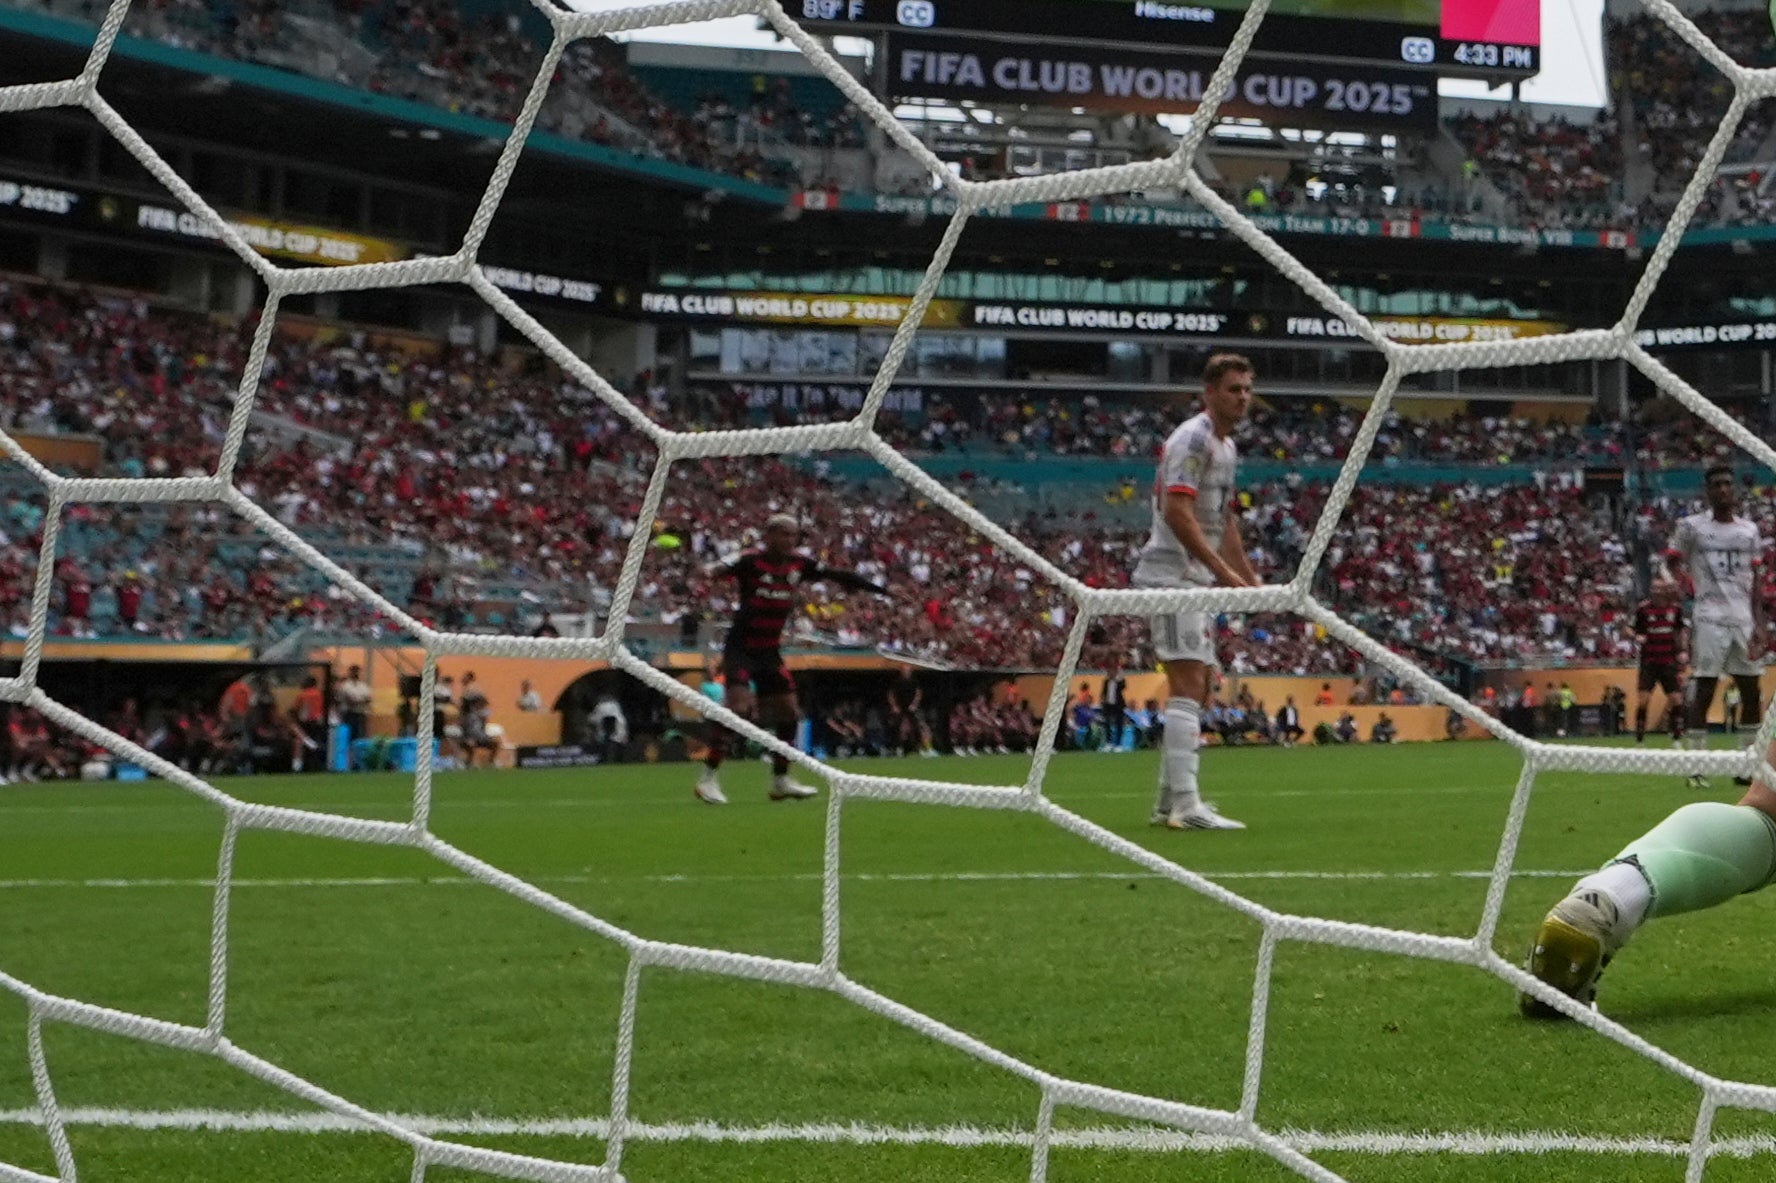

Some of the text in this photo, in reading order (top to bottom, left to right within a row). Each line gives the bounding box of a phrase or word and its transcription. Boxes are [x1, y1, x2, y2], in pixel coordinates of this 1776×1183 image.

[1135, 0, 1215, 24] Hisense
[1503, 46, 1532, 68] PM
[902, 49, 984, 88] FIFA
[993, 53, 1092, 95] CLUB
[1243, 75, 1318, 108] CUP
[138, 205, 177, 233] FIFA
[642, 293, 680, 314] FIFA
[681, 294, 734, 315] CLUB
[735, 298, 808, 318] WORLD
[810, 300, 850, 319] CUP
[975, 306, 1015, 326] FIFA
[1016, 307, 1065, 327] CLUB
[1067, 309, 1133, 330] WORLD
[1136, 312, 1172, 331] CUP
[1287, 318, 1325, 336] FIFA
[1434, 324, 1470, 341] CUP
[1657, 326, 1717, 345] WORLD
[1718, 323, 1753, 342] CUP
